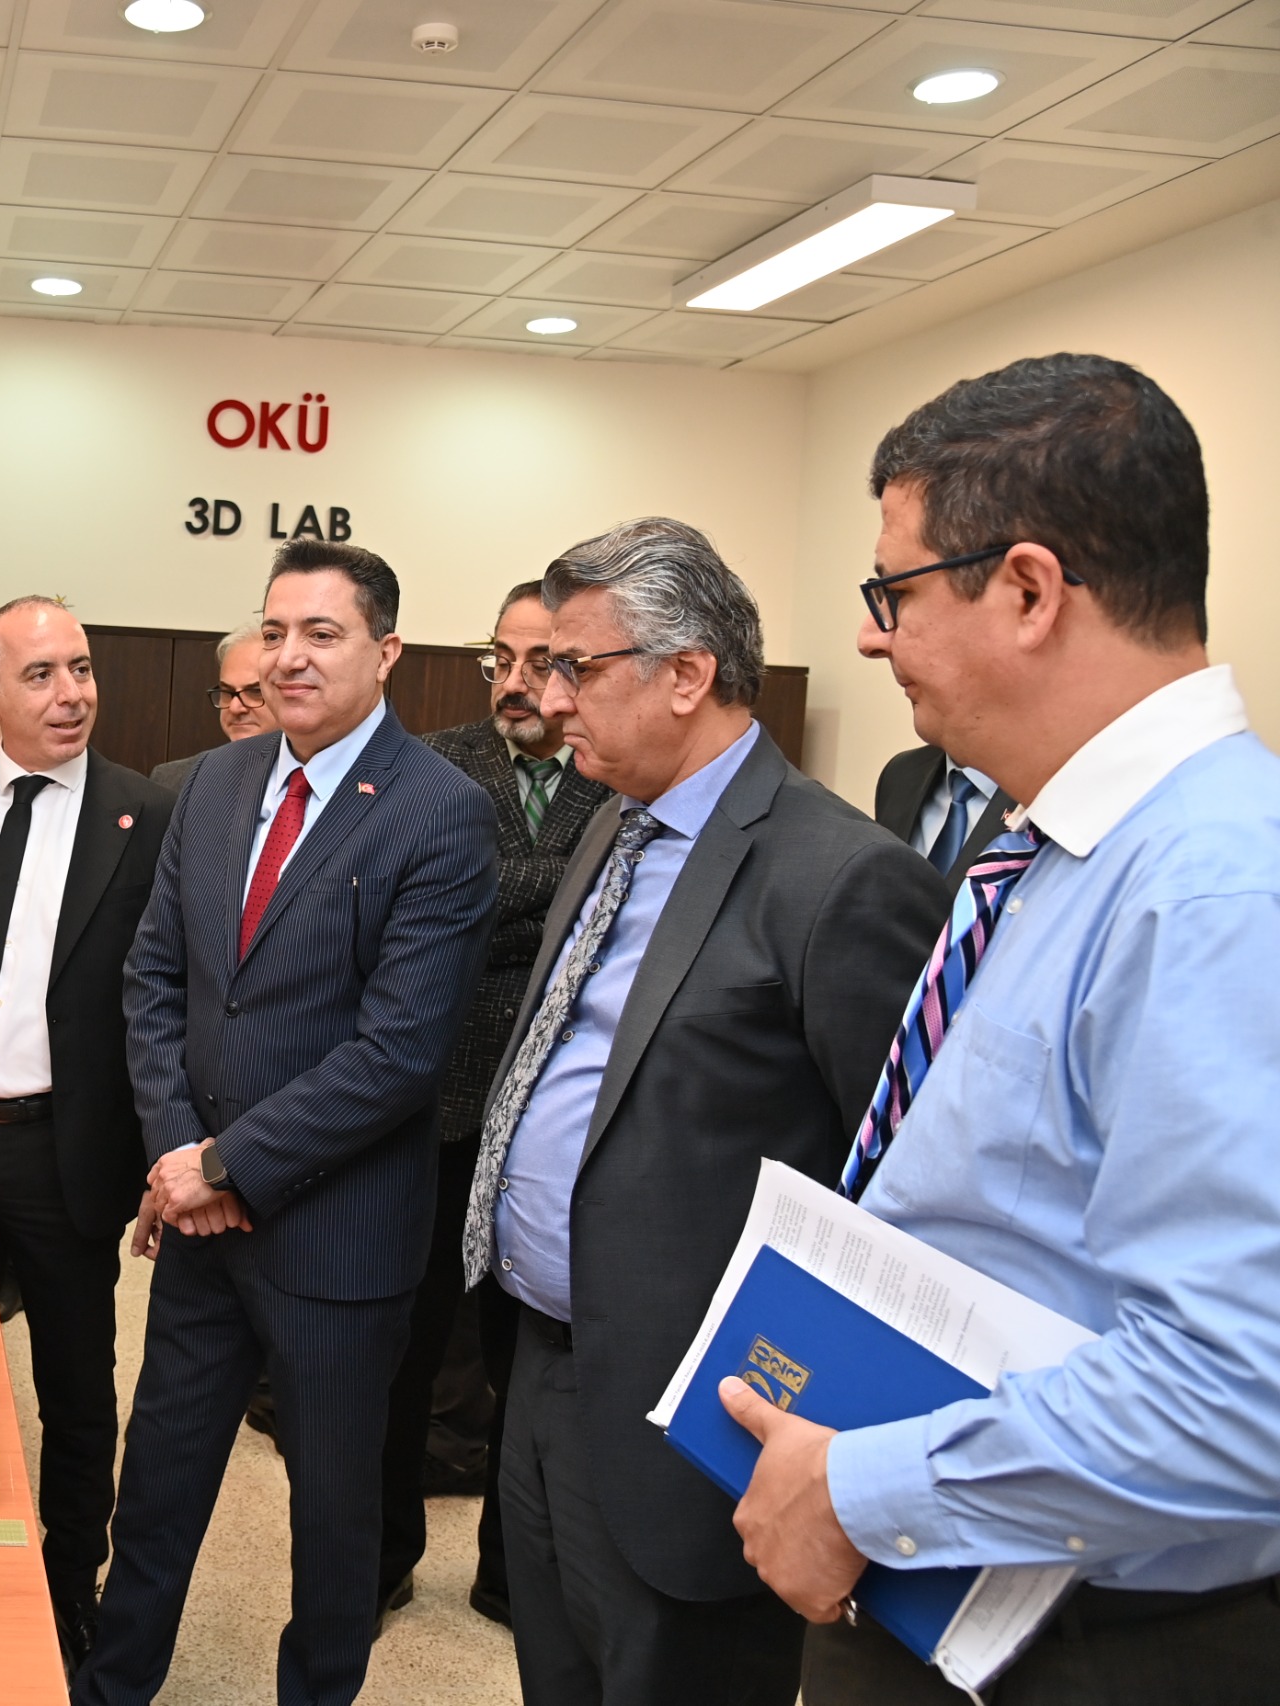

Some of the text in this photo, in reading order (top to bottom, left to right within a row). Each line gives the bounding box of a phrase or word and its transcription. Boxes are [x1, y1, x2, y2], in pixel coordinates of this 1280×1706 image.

[207, 392, 329, 453] OKÜ
[185, 497, 352, 542] 3D LAB
